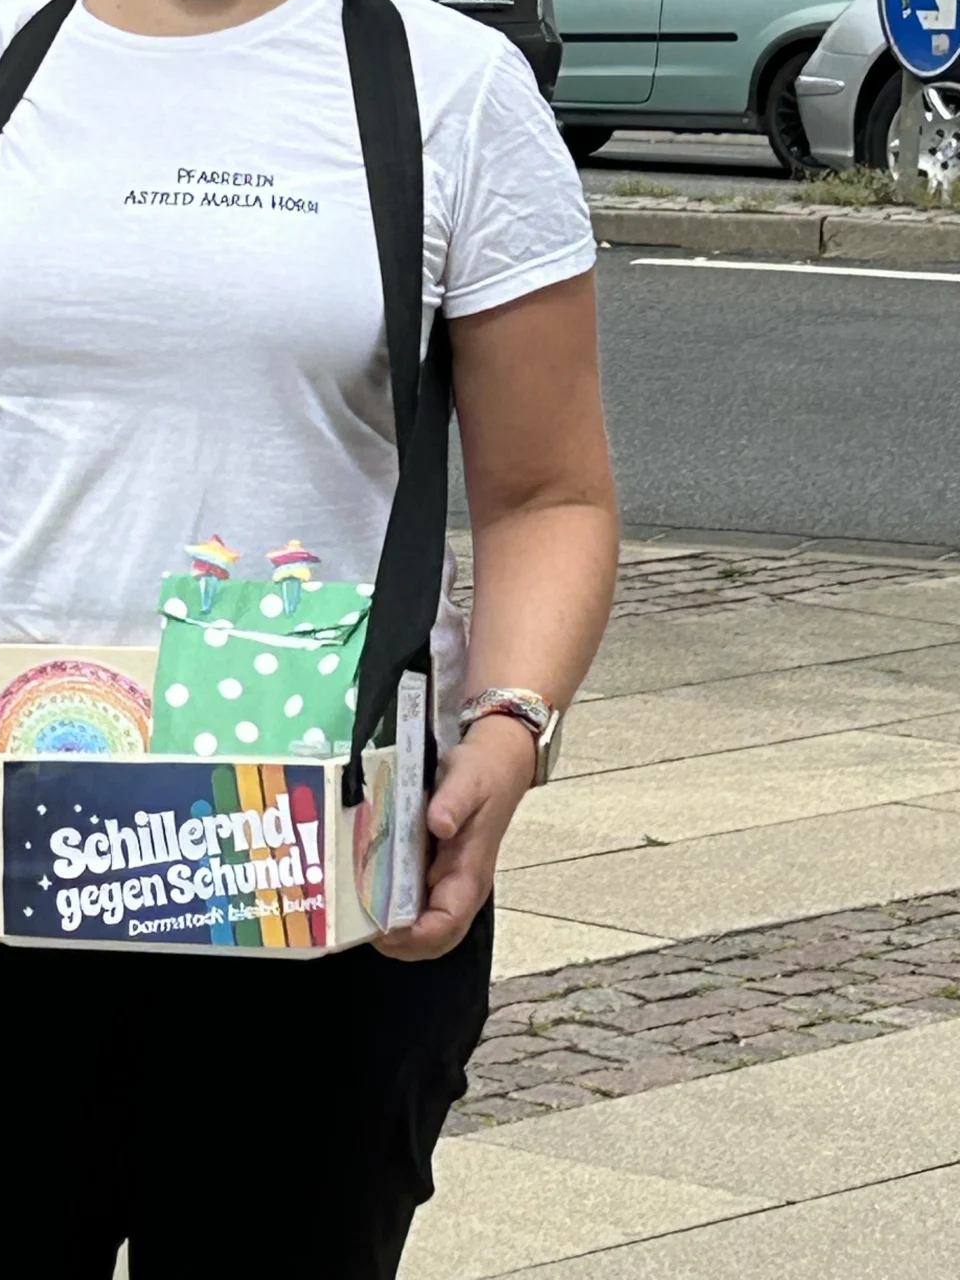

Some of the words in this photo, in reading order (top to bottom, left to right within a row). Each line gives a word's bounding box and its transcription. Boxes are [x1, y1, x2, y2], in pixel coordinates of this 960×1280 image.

[176, 167, 275, 188] PFARRERIN
[123, 189, 195, 206] ASTRID
[200, 192, 263, 209] MARIA
[49, 793, 297, 880] Schillernd
[55, 873, 169, 932] gegen
